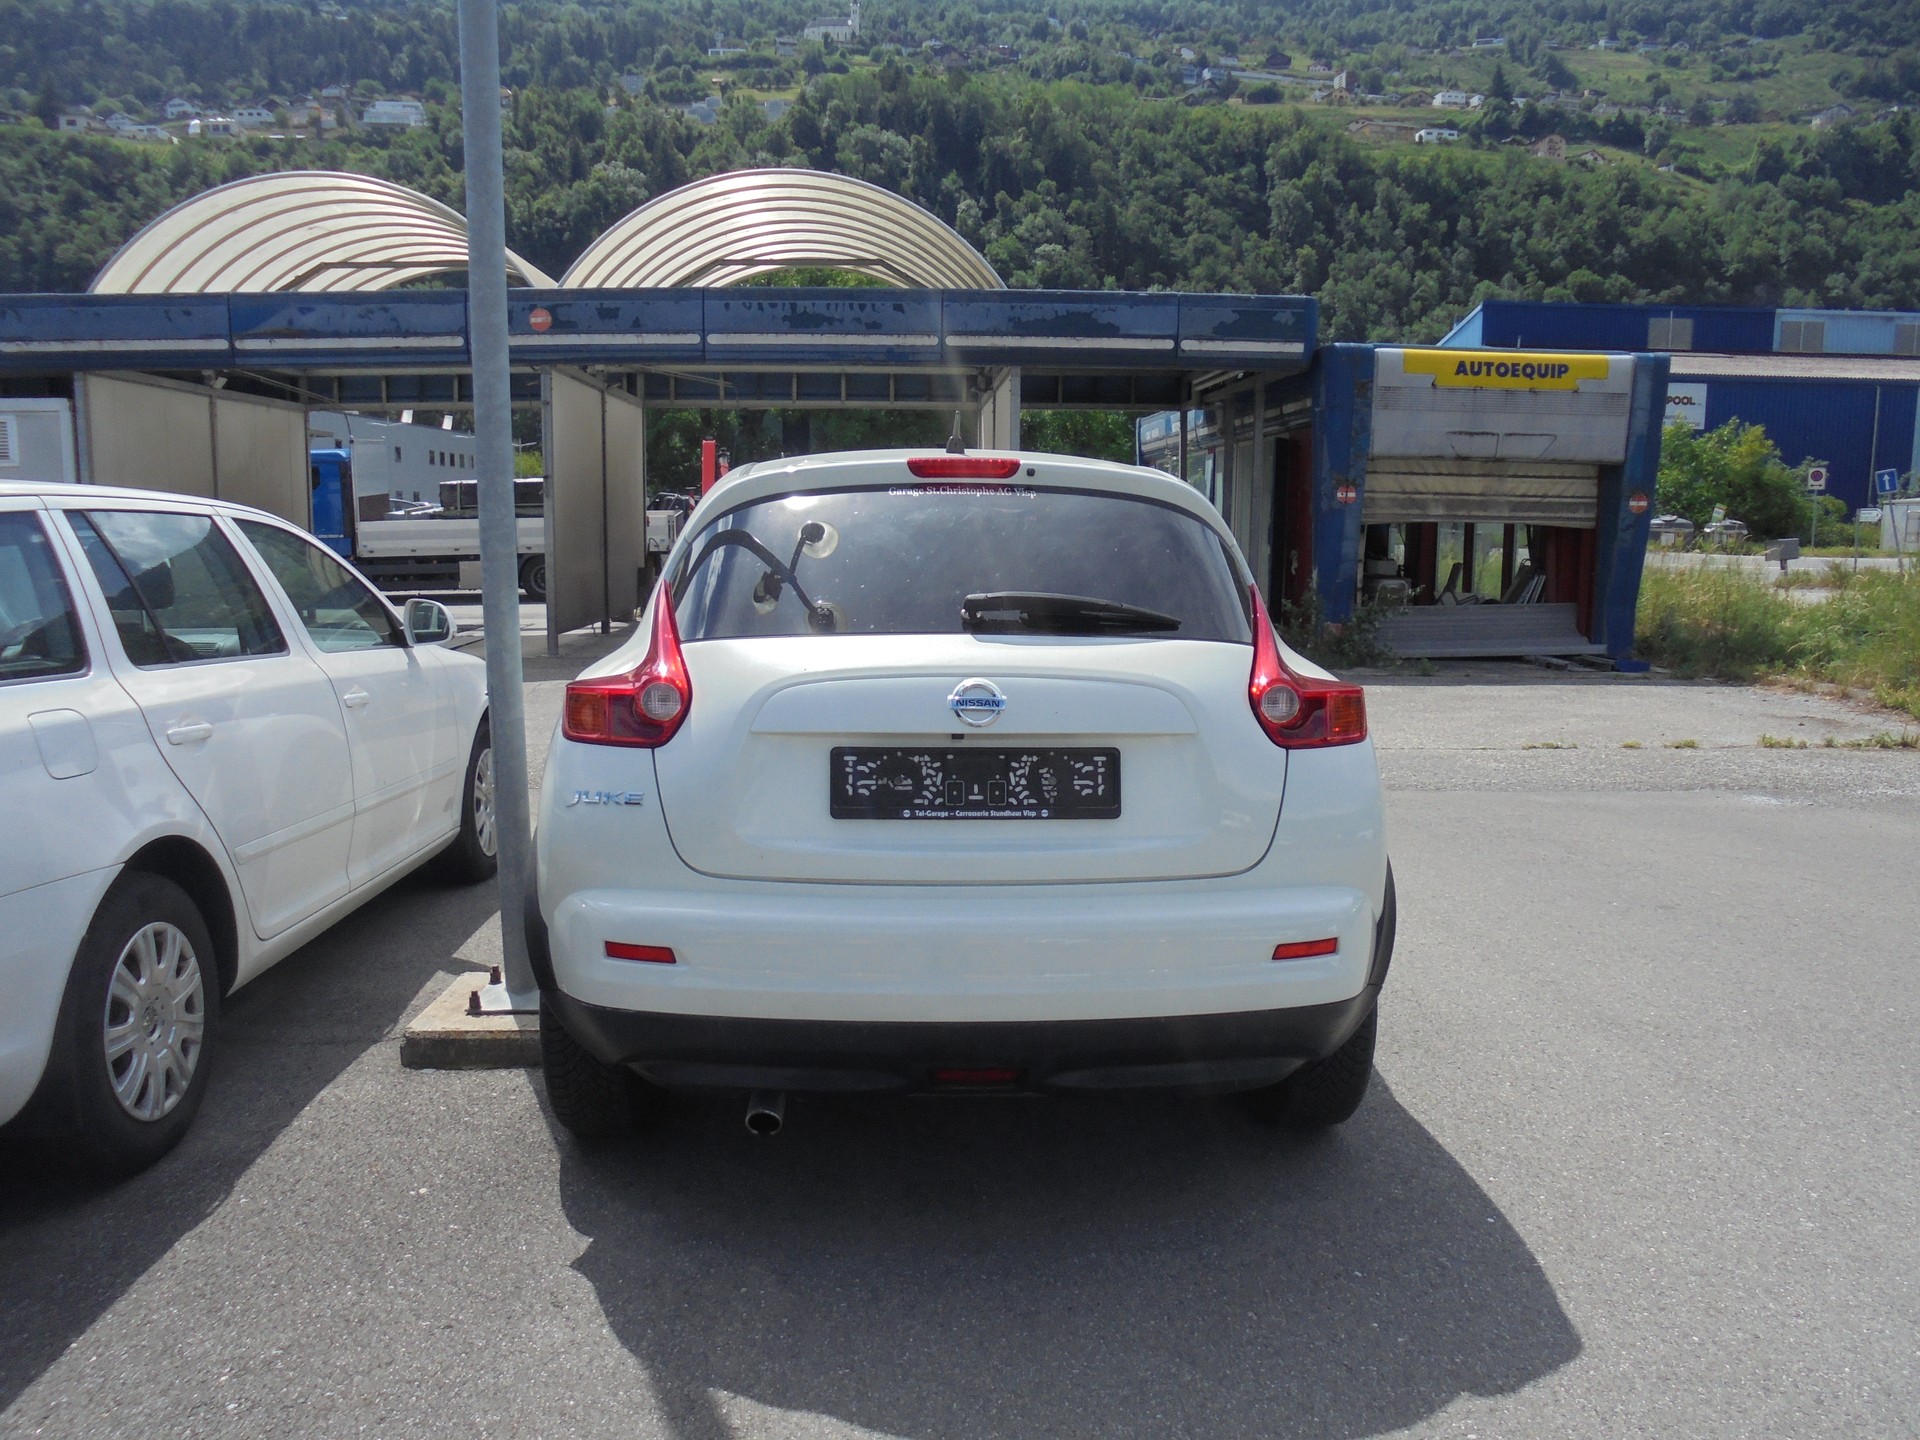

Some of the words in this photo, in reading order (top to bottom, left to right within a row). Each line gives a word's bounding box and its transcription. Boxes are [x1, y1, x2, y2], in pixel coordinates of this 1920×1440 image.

[1454, 360, 1570, 381] AUTOEQUIP
[888, 486, 925, 498] Garage
[996, 487, 1012, 497] AG
[1014, 487, 1037, 499] Visp
[955, 699, 1001, 708] NISSAN
[565, 790, 645, 808] JUKE
[1022, 809, 1037, 818] Visp
